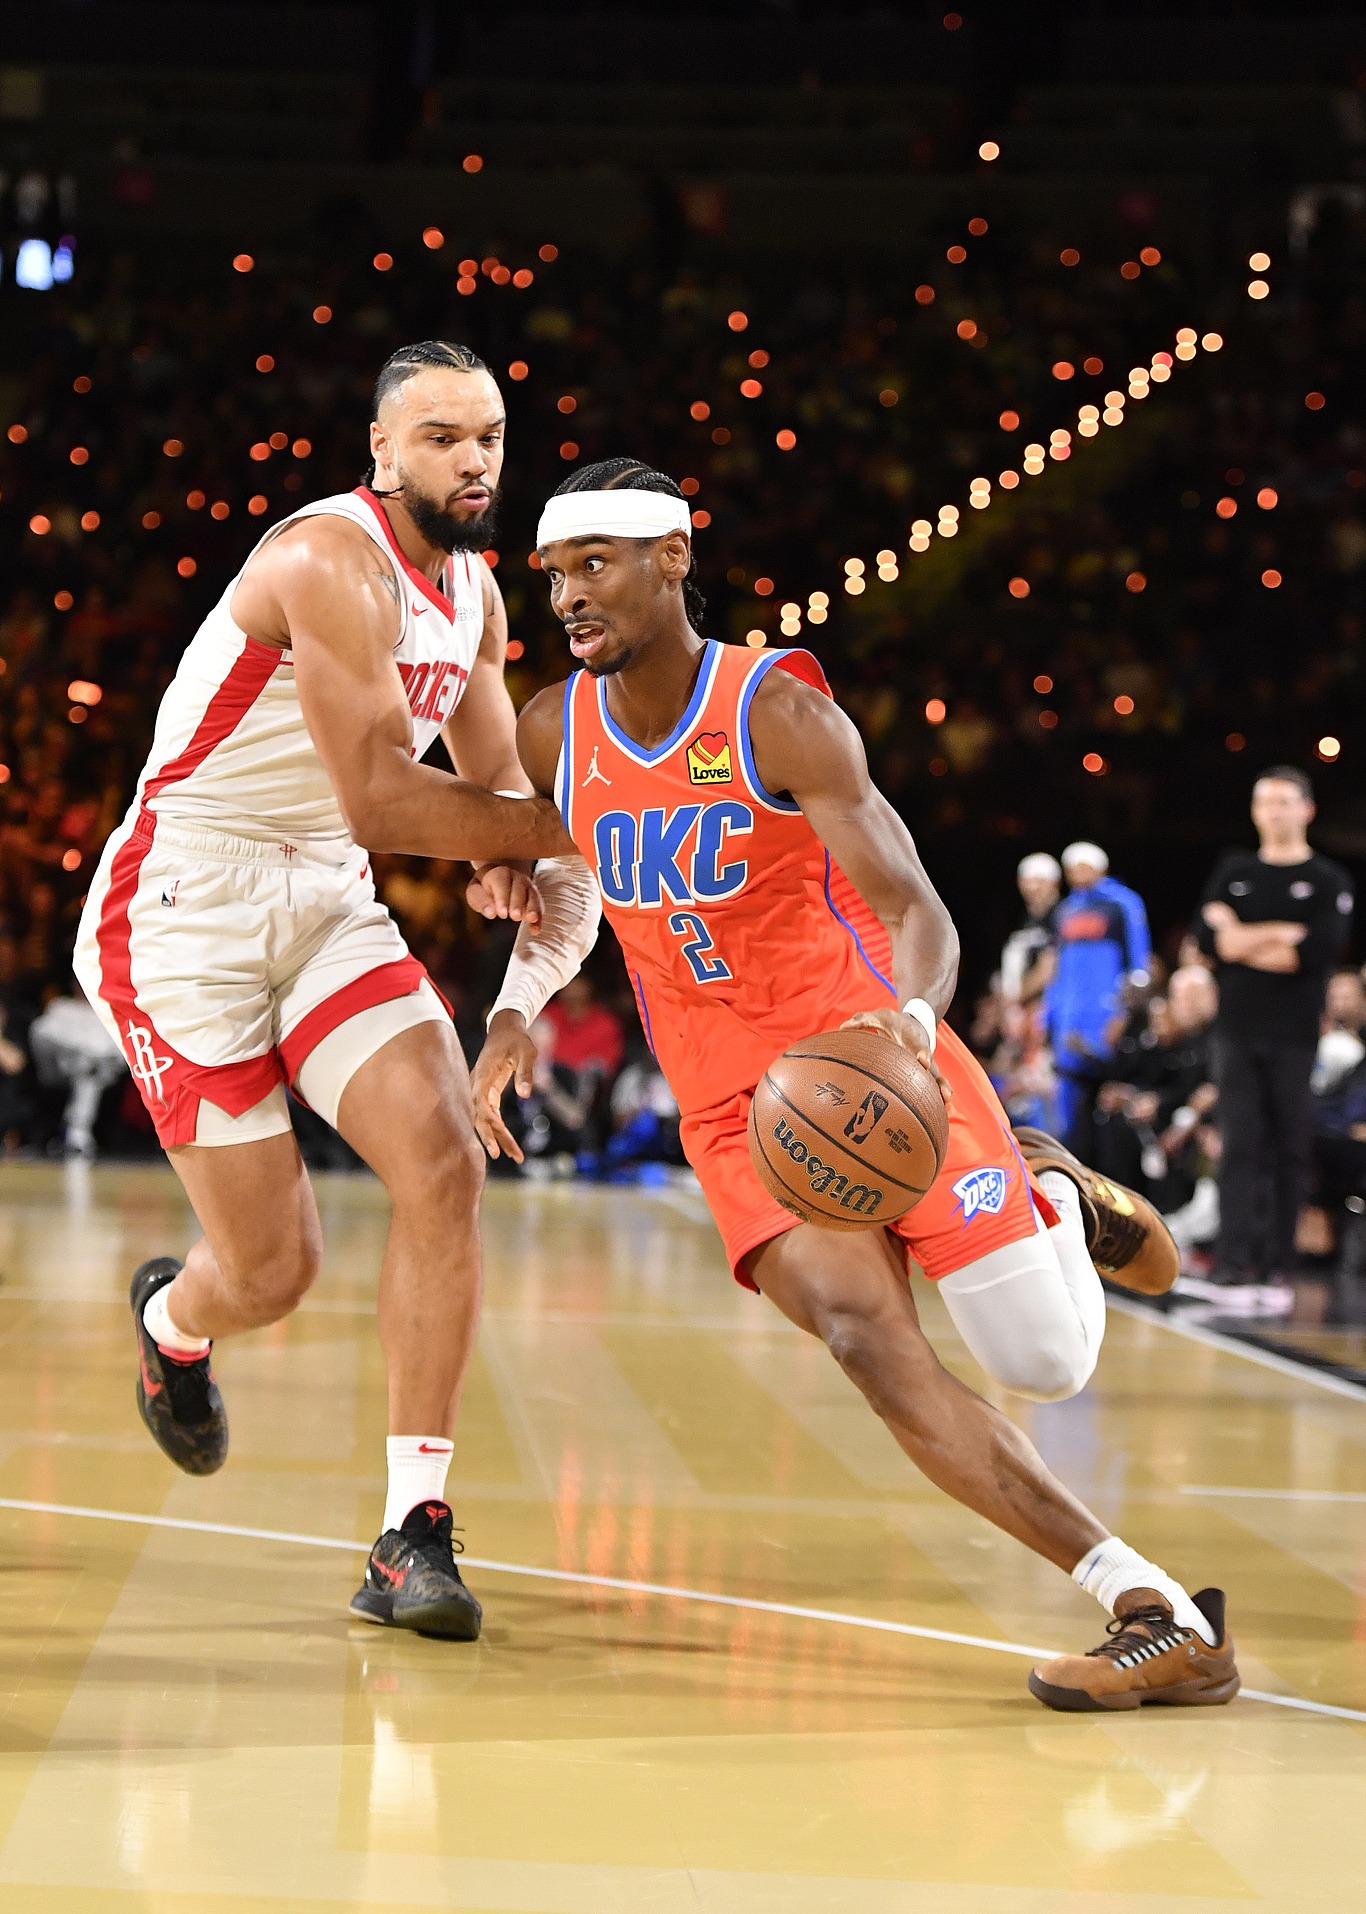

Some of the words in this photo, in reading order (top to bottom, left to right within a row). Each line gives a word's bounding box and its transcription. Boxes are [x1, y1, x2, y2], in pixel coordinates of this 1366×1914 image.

[593, 800, 754, 909] OKC
[667, 911, 734, 985] 2
[773, 1116, 884, 1215] Wilson
